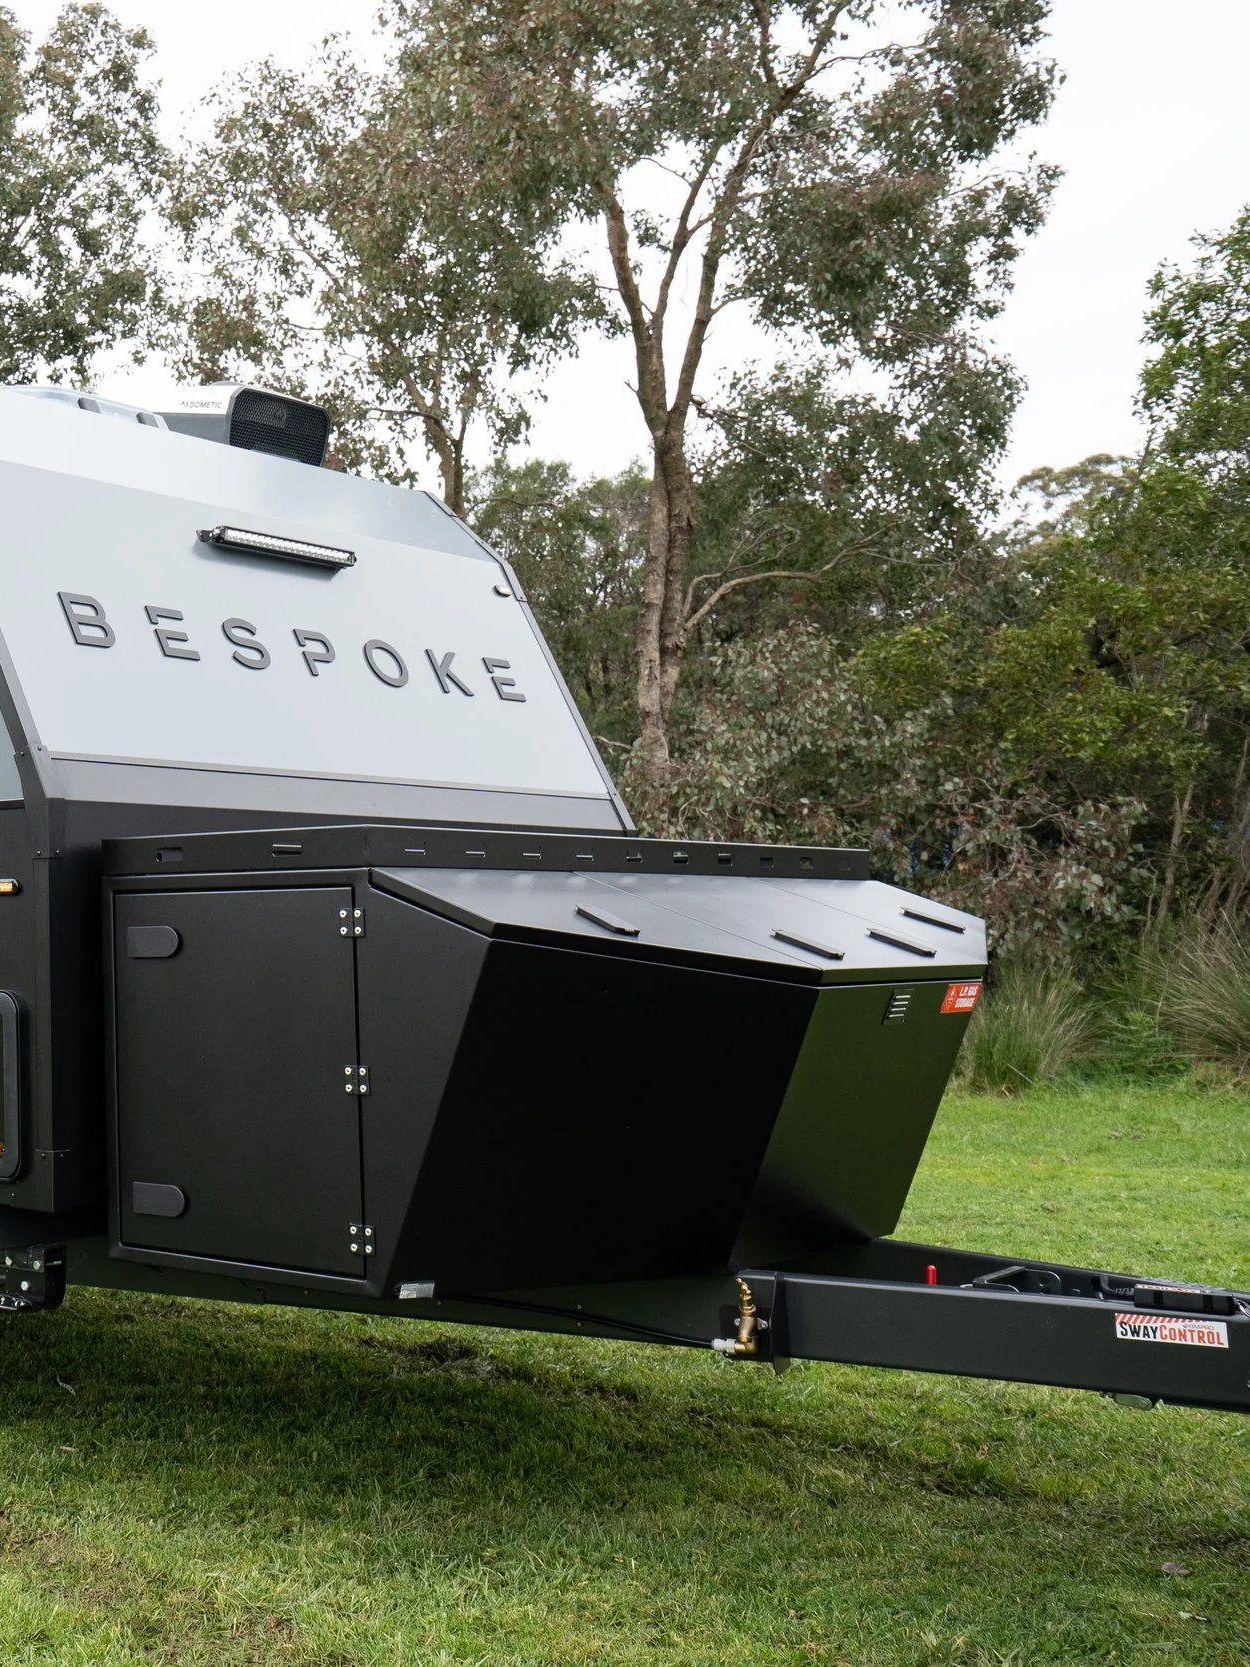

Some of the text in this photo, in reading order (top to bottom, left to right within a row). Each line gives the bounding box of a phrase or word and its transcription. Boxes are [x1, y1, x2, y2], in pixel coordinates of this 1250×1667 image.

[190, 401, 222, 409] DOMETIC
[57, 591, 527, 703] BESPOKE
[968, 986, 978, 996] GAS
[954, 998, 975, 1008] STORAGE
